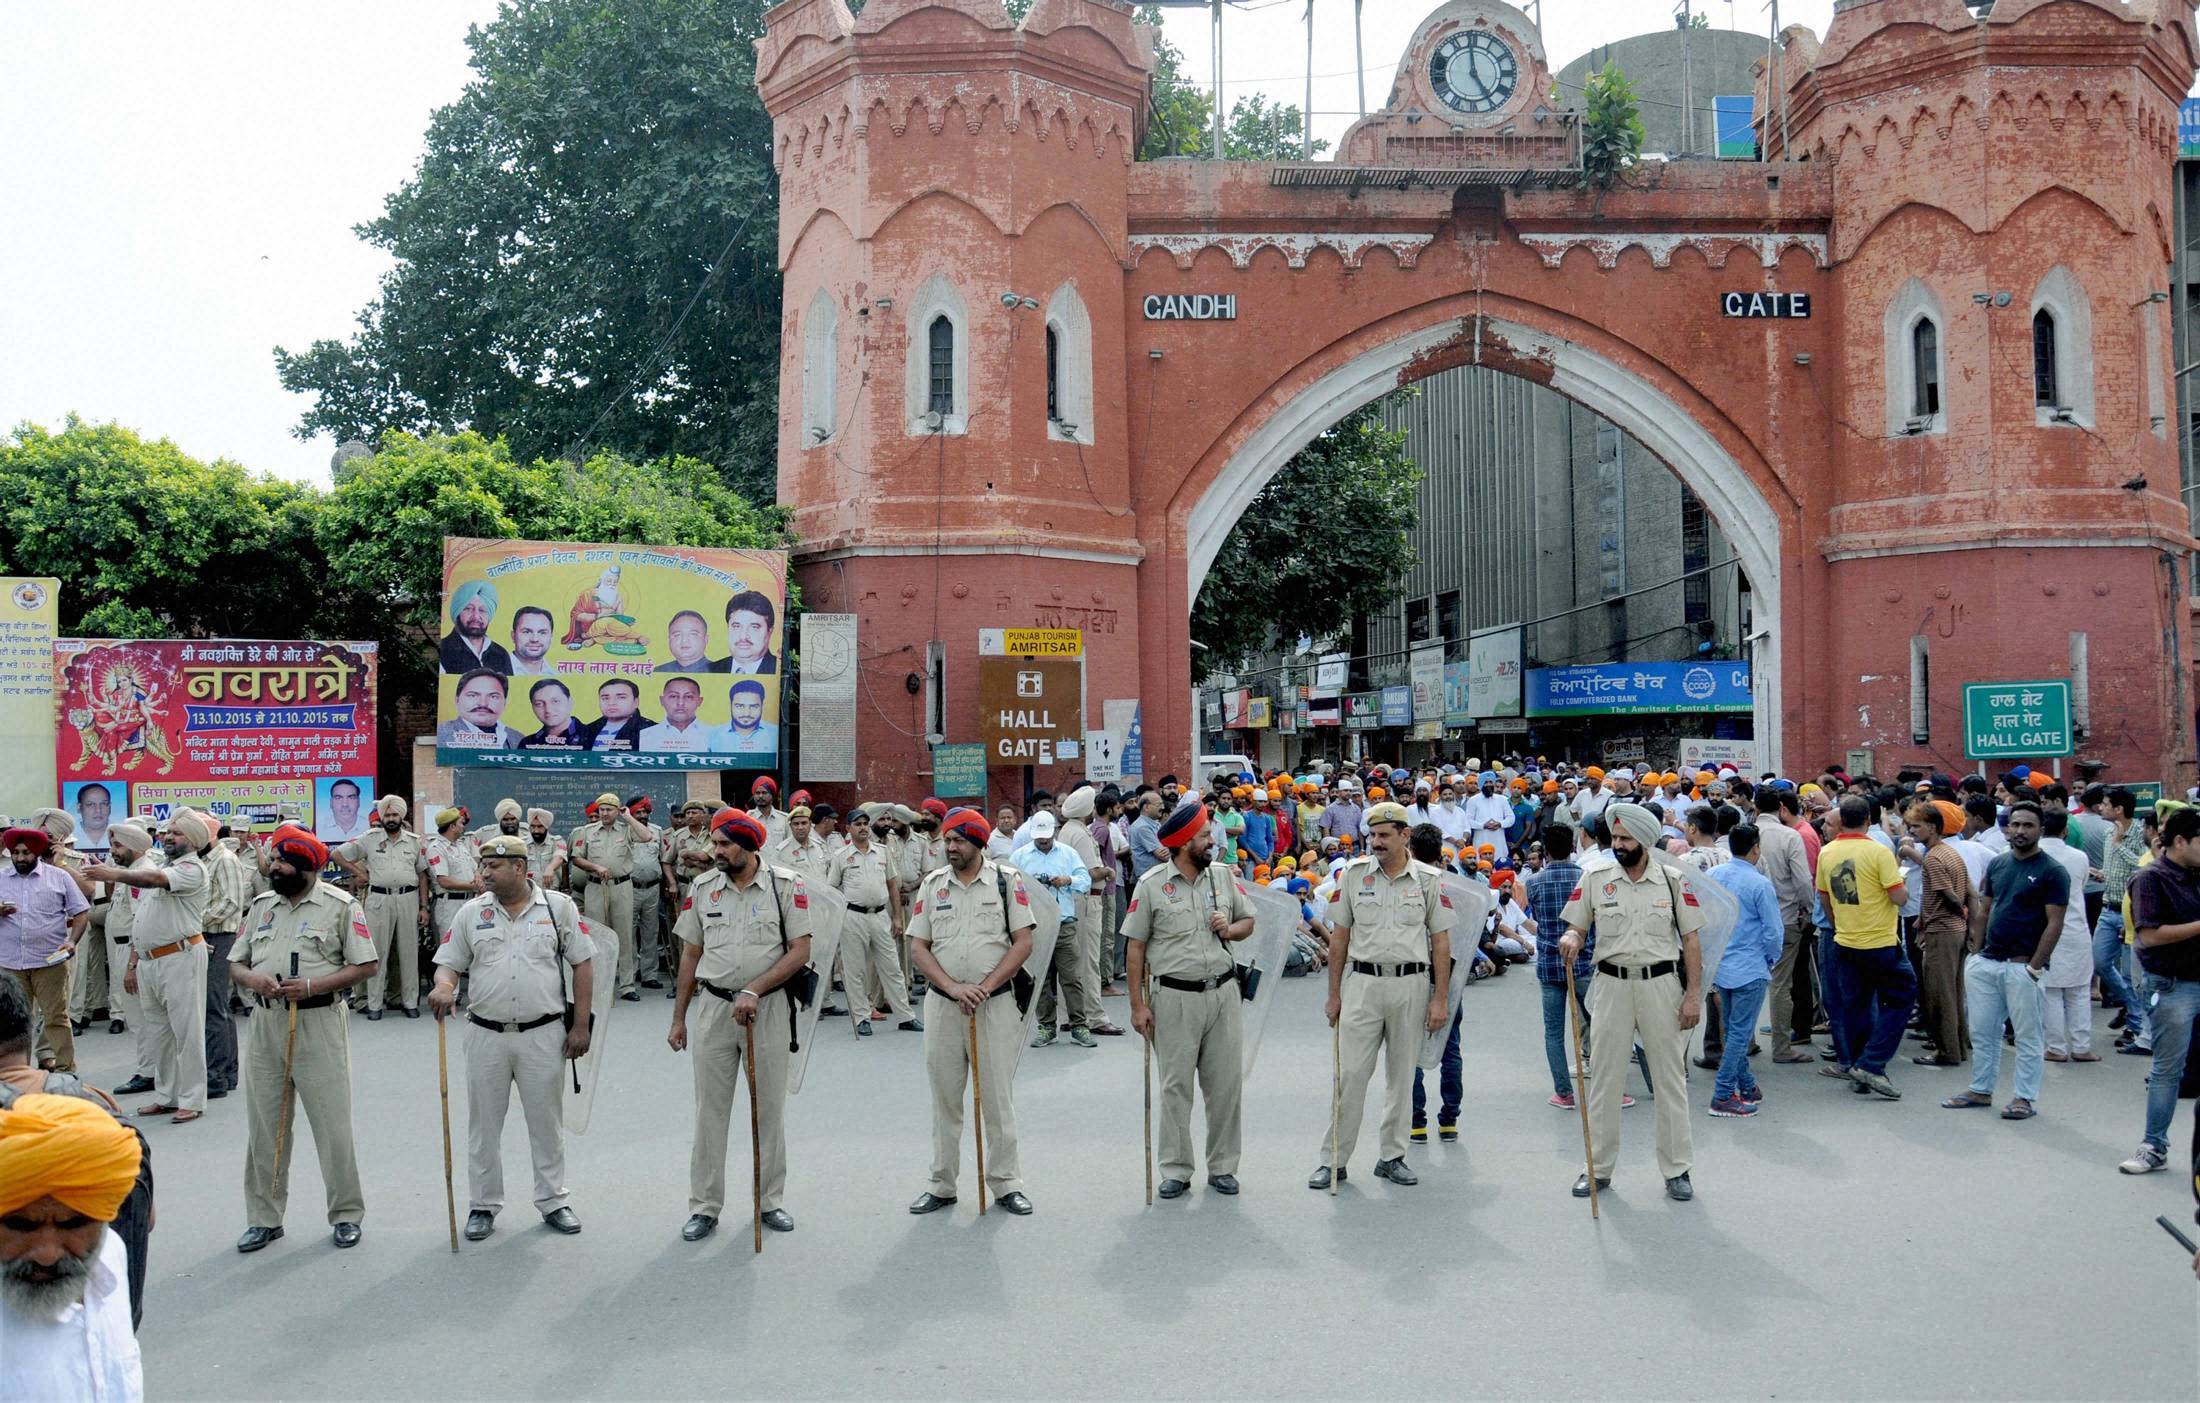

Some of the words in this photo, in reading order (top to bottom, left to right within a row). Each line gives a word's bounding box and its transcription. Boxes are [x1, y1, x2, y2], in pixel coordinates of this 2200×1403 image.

[1144, 295, 1236, 319] GANDHI
[1725, 292, 1807, 317] GATE
[1008, 632, 1040, 640] PUNJAB
[1043, 632, 1077, 640] TOURISM
[181, 644, 194, 662] श्री
[198, 645, 243, 662] नवशक्ति
[248, 645, 261, 662] डेरे
[265, 644, 278, 661] की
[282, 646, 301, 662] ओर
[305, 646, 315, 661] से
[1010, 642, 1076, 652] AMRITSAR
[557, 661, 587, 674] लाख
[590, 662, 618, 676] लाख
[621, 659, 654, 678] बधाई
[184, 654, 357, 702] नवरात्रे
[1550, 674, 1629, 696] ਕੋਆਪ੍ਰੇਟਿਵ
[1633, 672, 1667, 689] ਬੈਂਕ
[1566, 695, 1616, 705] COMPUTERIZED
[1989, 694, 2016, 707] ਹਾਲ
[2021, 689, 2044, 706] ਗੇਟ
[1631, 705, 1670, 713] Amritsar
[1675, 704, 1709, 712] Central
[192, 713, 251, 725] 13.10.2015
[255, 711, 266, 724] से
[332, 713, 349, 723] तक
[1000, 710, 1056, 728] HALL
[1992, 714, 2020, 730] हाल
[2022, 709, 2042, 726] गेट
[998, 738, 1051, 757] GATE
[1977, 733, 2017, 747] HALL
[2021, 731, 2062, 745] GATE
[174, 786, 216, 799] प्रसारण
[231, 786, 250, 797] रात
[257, 785, 265, 797] 9
[269, 783, 290, 796] बजे
[295, 783, 307, 795] से
[211, 802, 230, 814] 550
